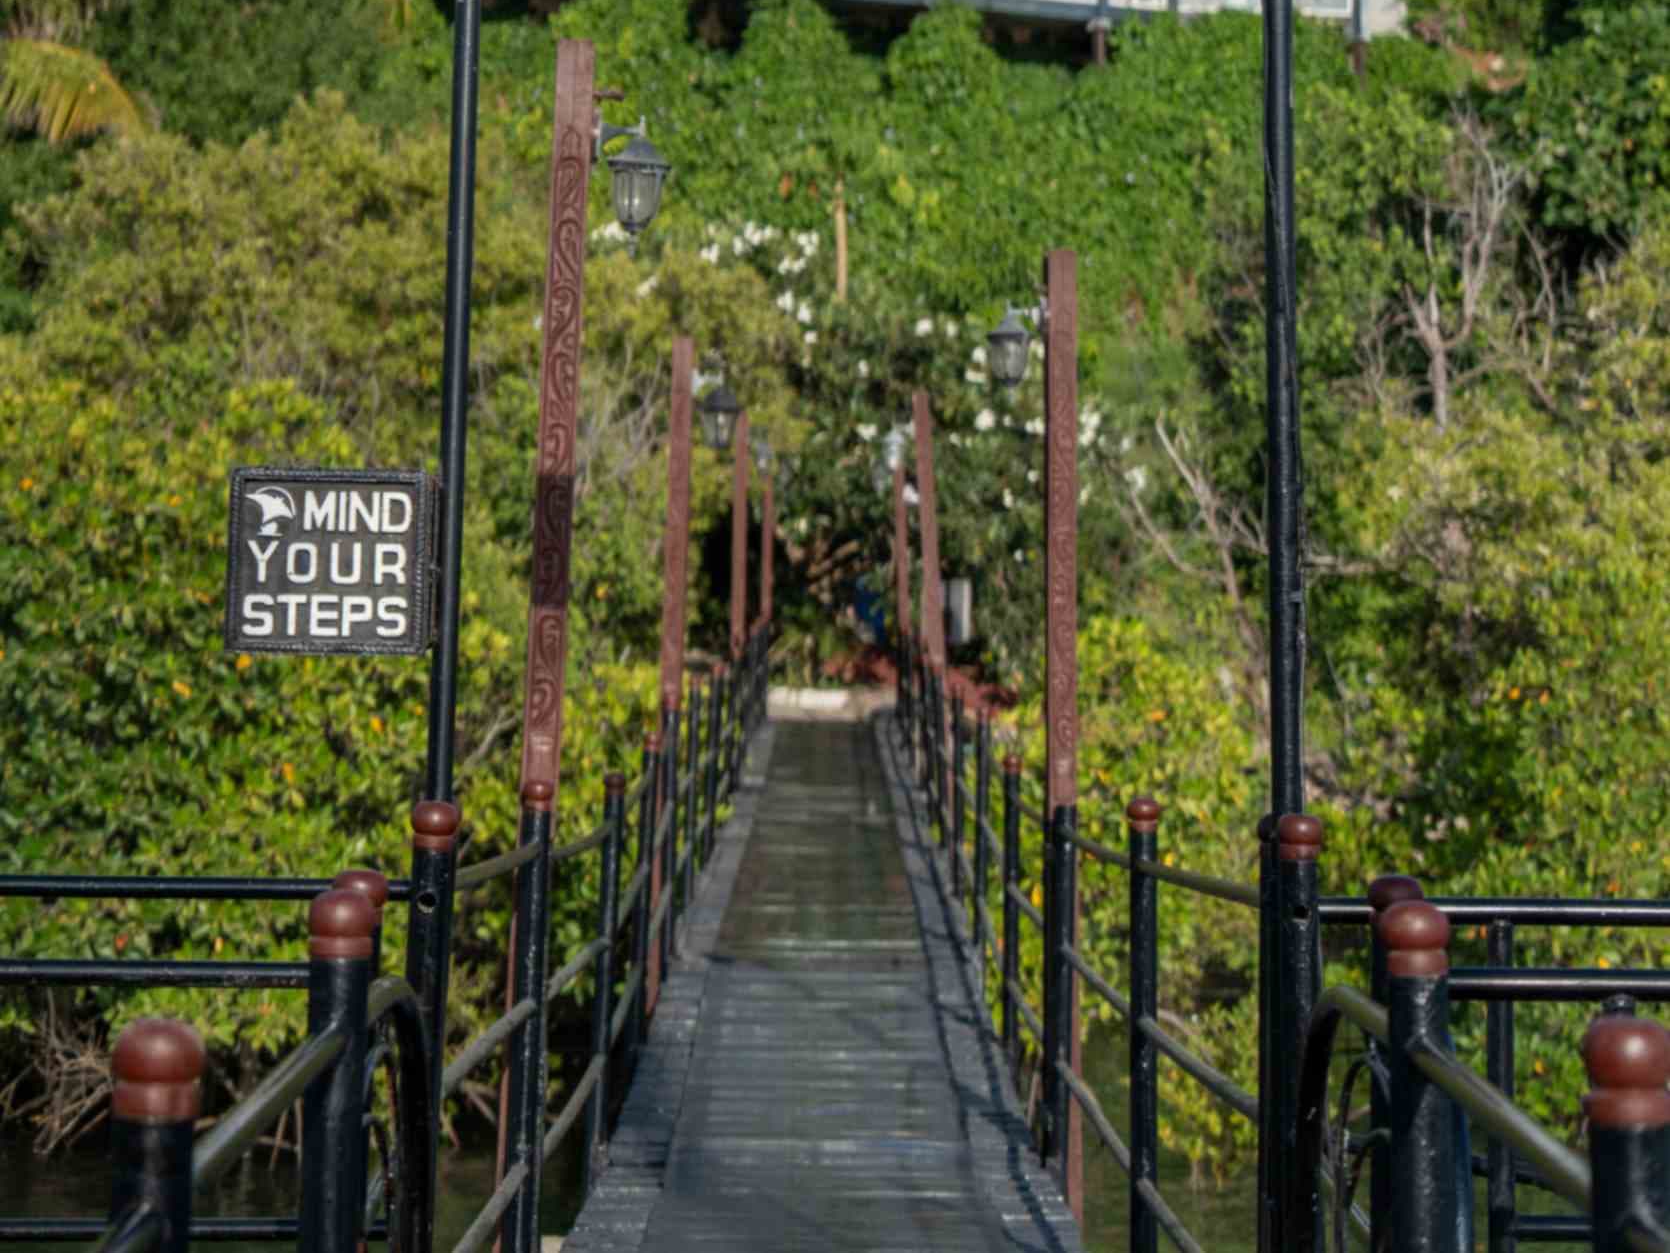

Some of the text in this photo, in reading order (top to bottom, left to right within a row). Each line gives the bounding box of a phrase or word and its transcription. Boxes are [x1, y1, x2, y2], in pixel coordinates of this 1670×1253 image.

[302, 489, 413, 533] MIND
[247, 539, 408, 585] YOUR
[241, 593, 409, 638] STEPS
